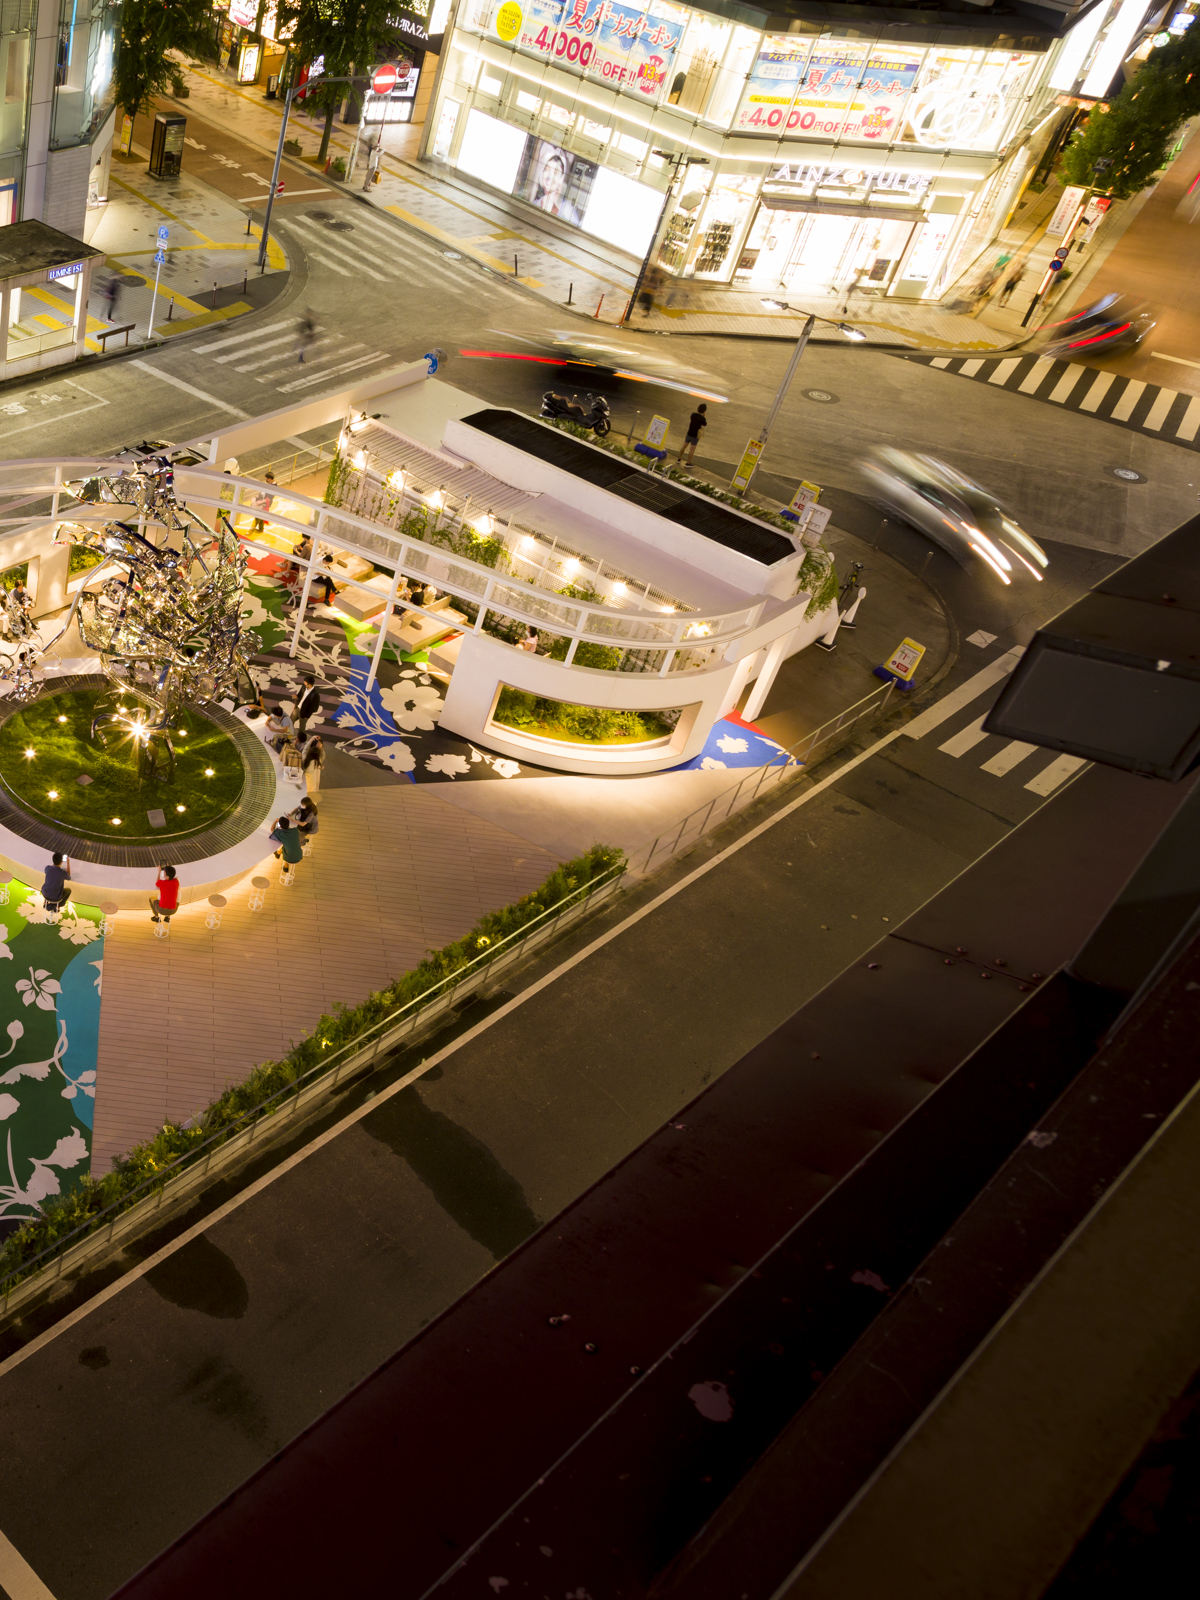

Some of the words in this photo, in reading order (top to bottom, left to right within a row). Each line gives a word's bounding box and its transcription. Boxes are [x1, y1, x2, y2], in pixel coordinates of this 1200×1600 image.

[774, 162, 844, 185] AINZ
[864, 170, 932, 191] TULPE
[73, 263, 84, 273] EST
